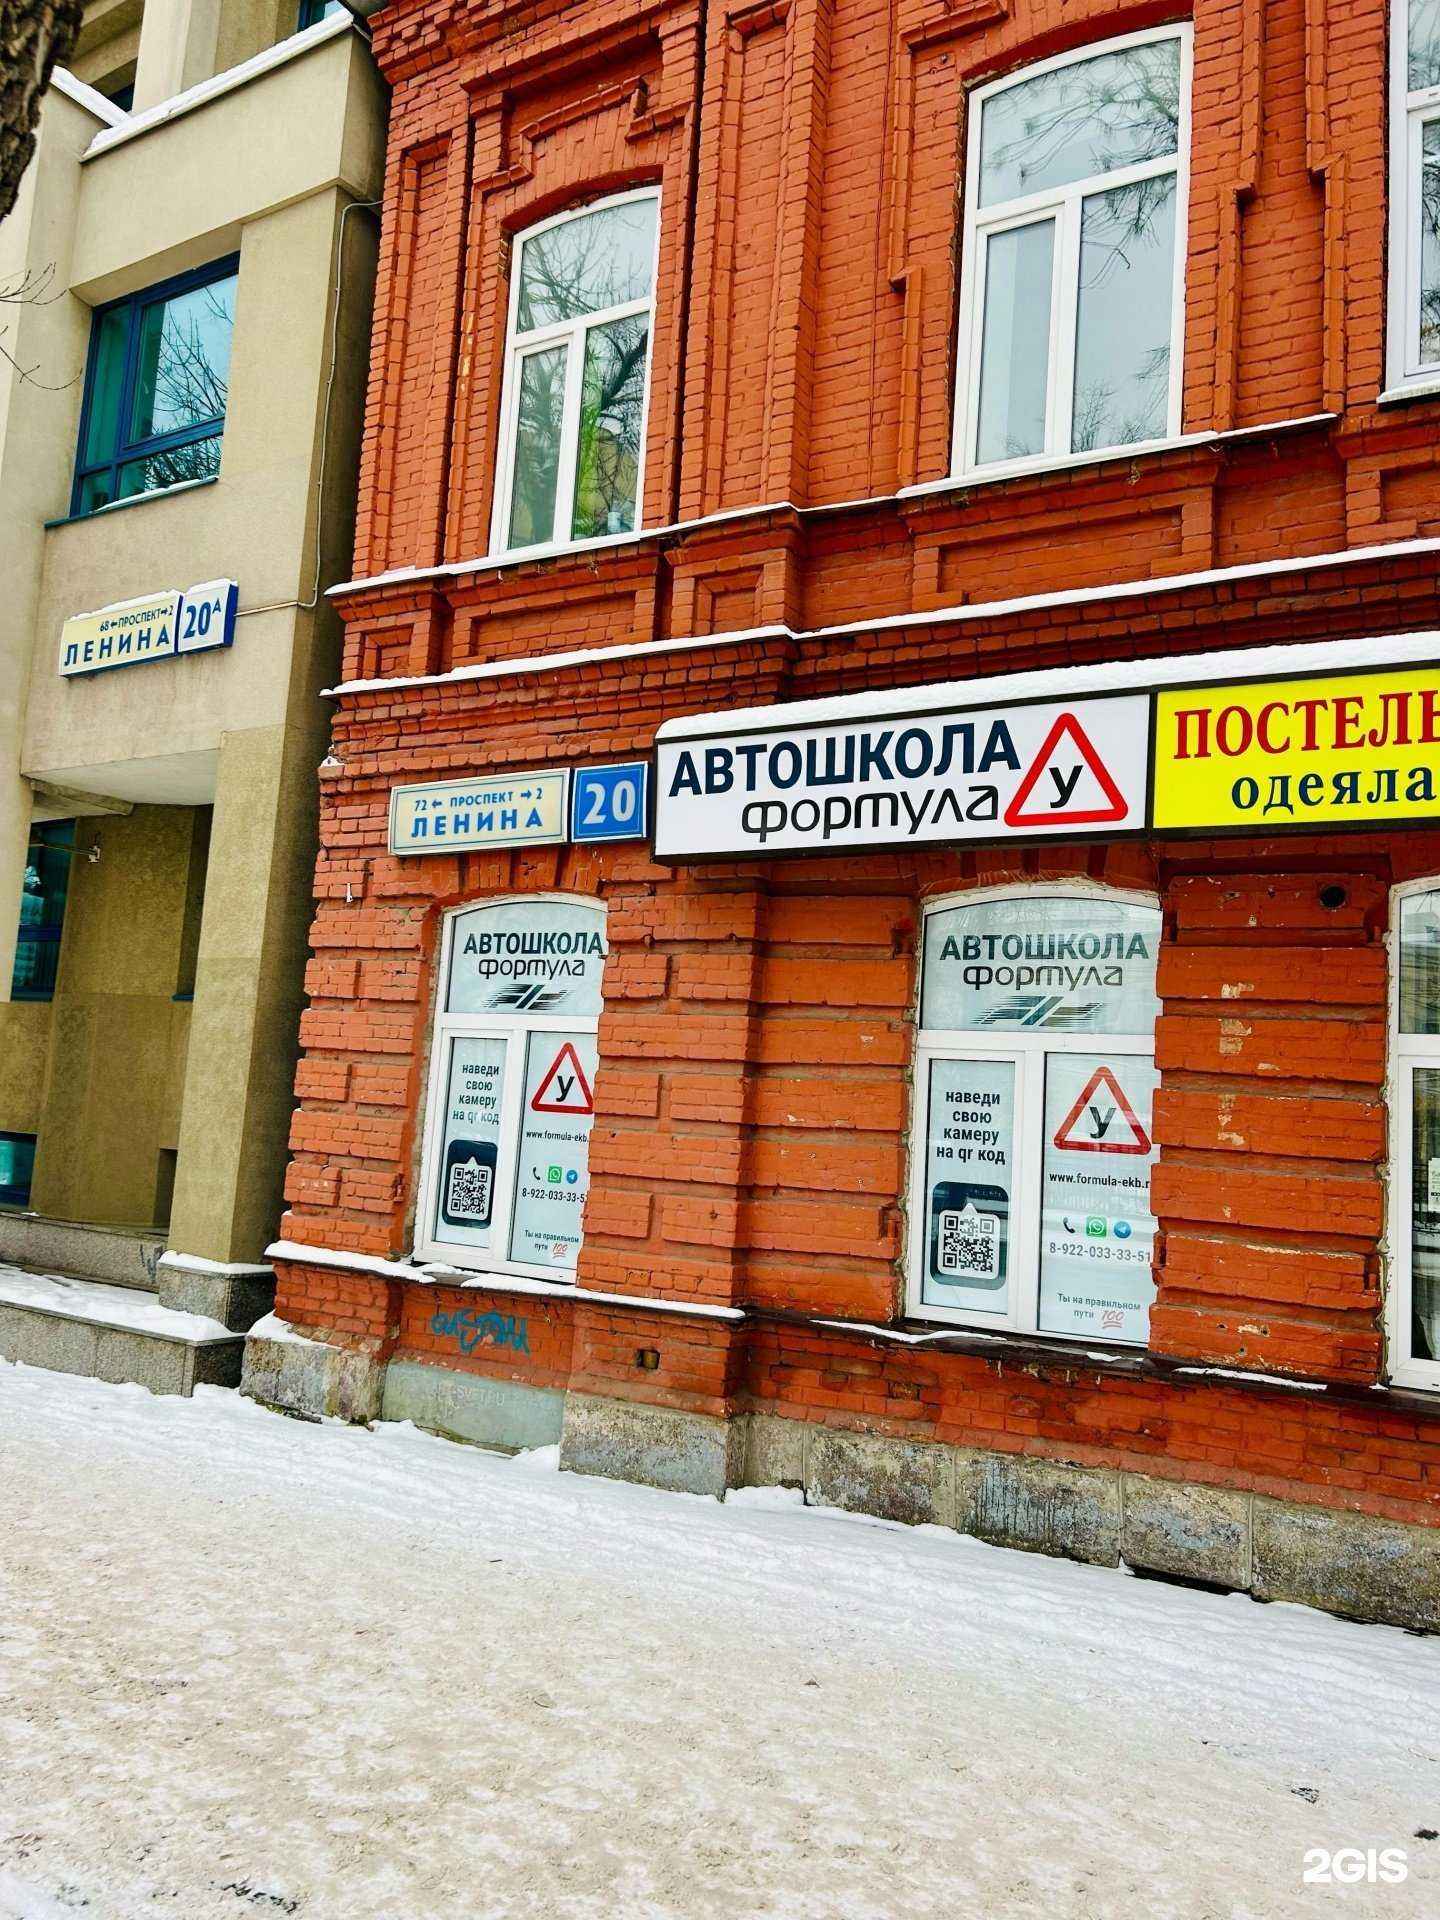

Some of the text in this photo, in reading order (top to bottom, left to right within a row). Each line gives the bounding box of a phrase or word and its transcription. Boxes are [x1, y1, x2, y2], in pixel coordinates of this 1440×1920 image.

[118, 607, 162, 628] ПРОСПЕКТ
[168, 604, 174, 616] 2
[64, 623, 170, 667] ЛЕНИНА
[668, 719, 1022, 798] АВТОШКОЛА
[415, 787, 543, 812] 72 ПРОСПЕКТ 2
[1231, 766, 1437, 816] одеяла
[582, 779, 636, 826] 20
[411, 807, 543, 838] ЛЕНИНА
[741, 784, 999, 843] формула
[463, 931, 604, 955] АВТОШКОЛА
[939, 932, 1150, 961] АВТОШКОЛА
[478, 958, 586, 981] формула
[963, 965, 1123, 991] формула
[462, 1064, 500, 1078] наведи
[466, 1080, 493, 1091] свою
[458, 1094, 497, 1109] камеру
[945, 1091, 1001, 1108] наведи
[452, 1110, 500, 1126] на qr код
[952, 1110, 992, 1124] свою
[943, 1127, 1000, 1146] камеру
[936, 1146, 1006, 1166] на qr код
[525, 1229, 580, 1244] Ты на правильном
[534, 1242, 548, 1253] пути
[1058, 1292, 1141, 1311] Ты на правильном
[1073, 1308, 1094, 1320] пути
